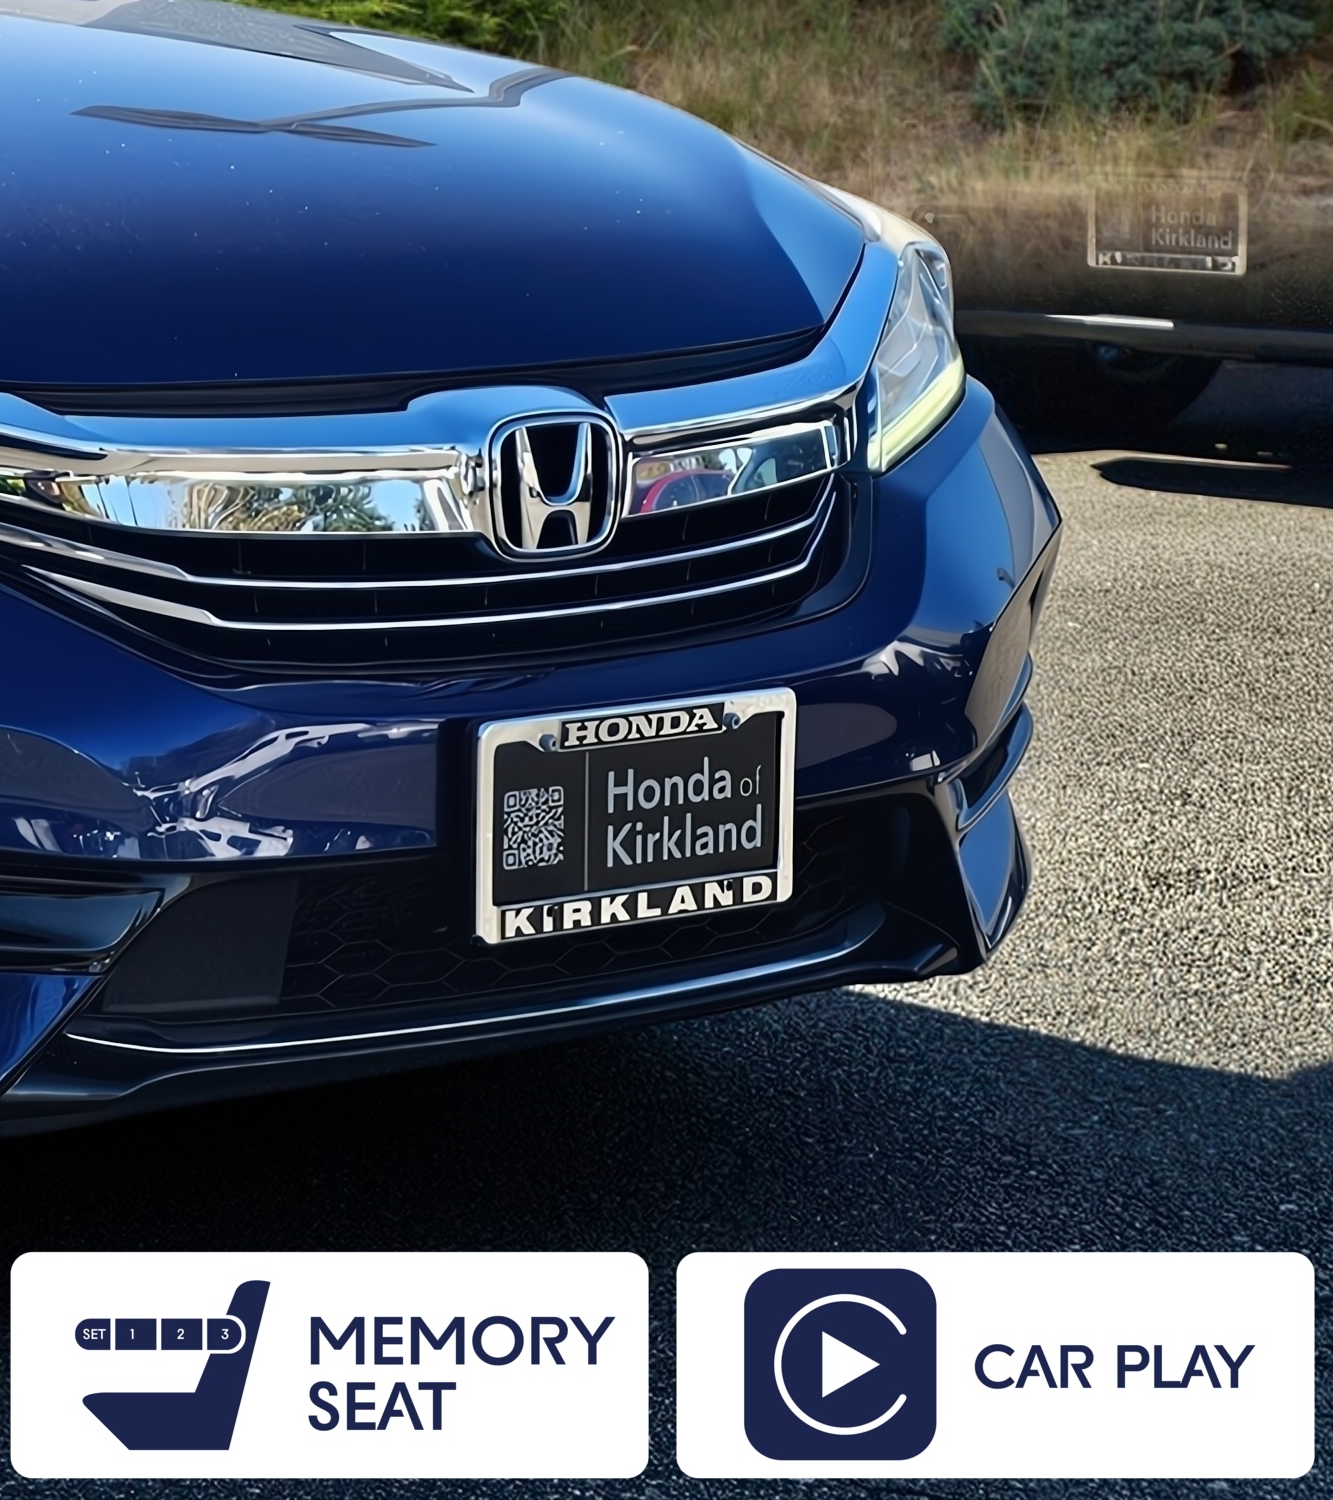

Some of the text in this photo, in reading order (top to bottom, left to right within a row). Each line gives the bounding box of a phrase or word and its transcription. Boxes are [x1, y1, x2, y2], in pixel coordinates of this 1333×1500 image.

[1151, 228, 1233, 250] Kirkland
[564, 708, 719, 747] HONDA
[607, 756, 762, 814] Honda of
[606, 803, 763, 868] Kirkland
[504, 875, 774, 938] KIRKLAND
